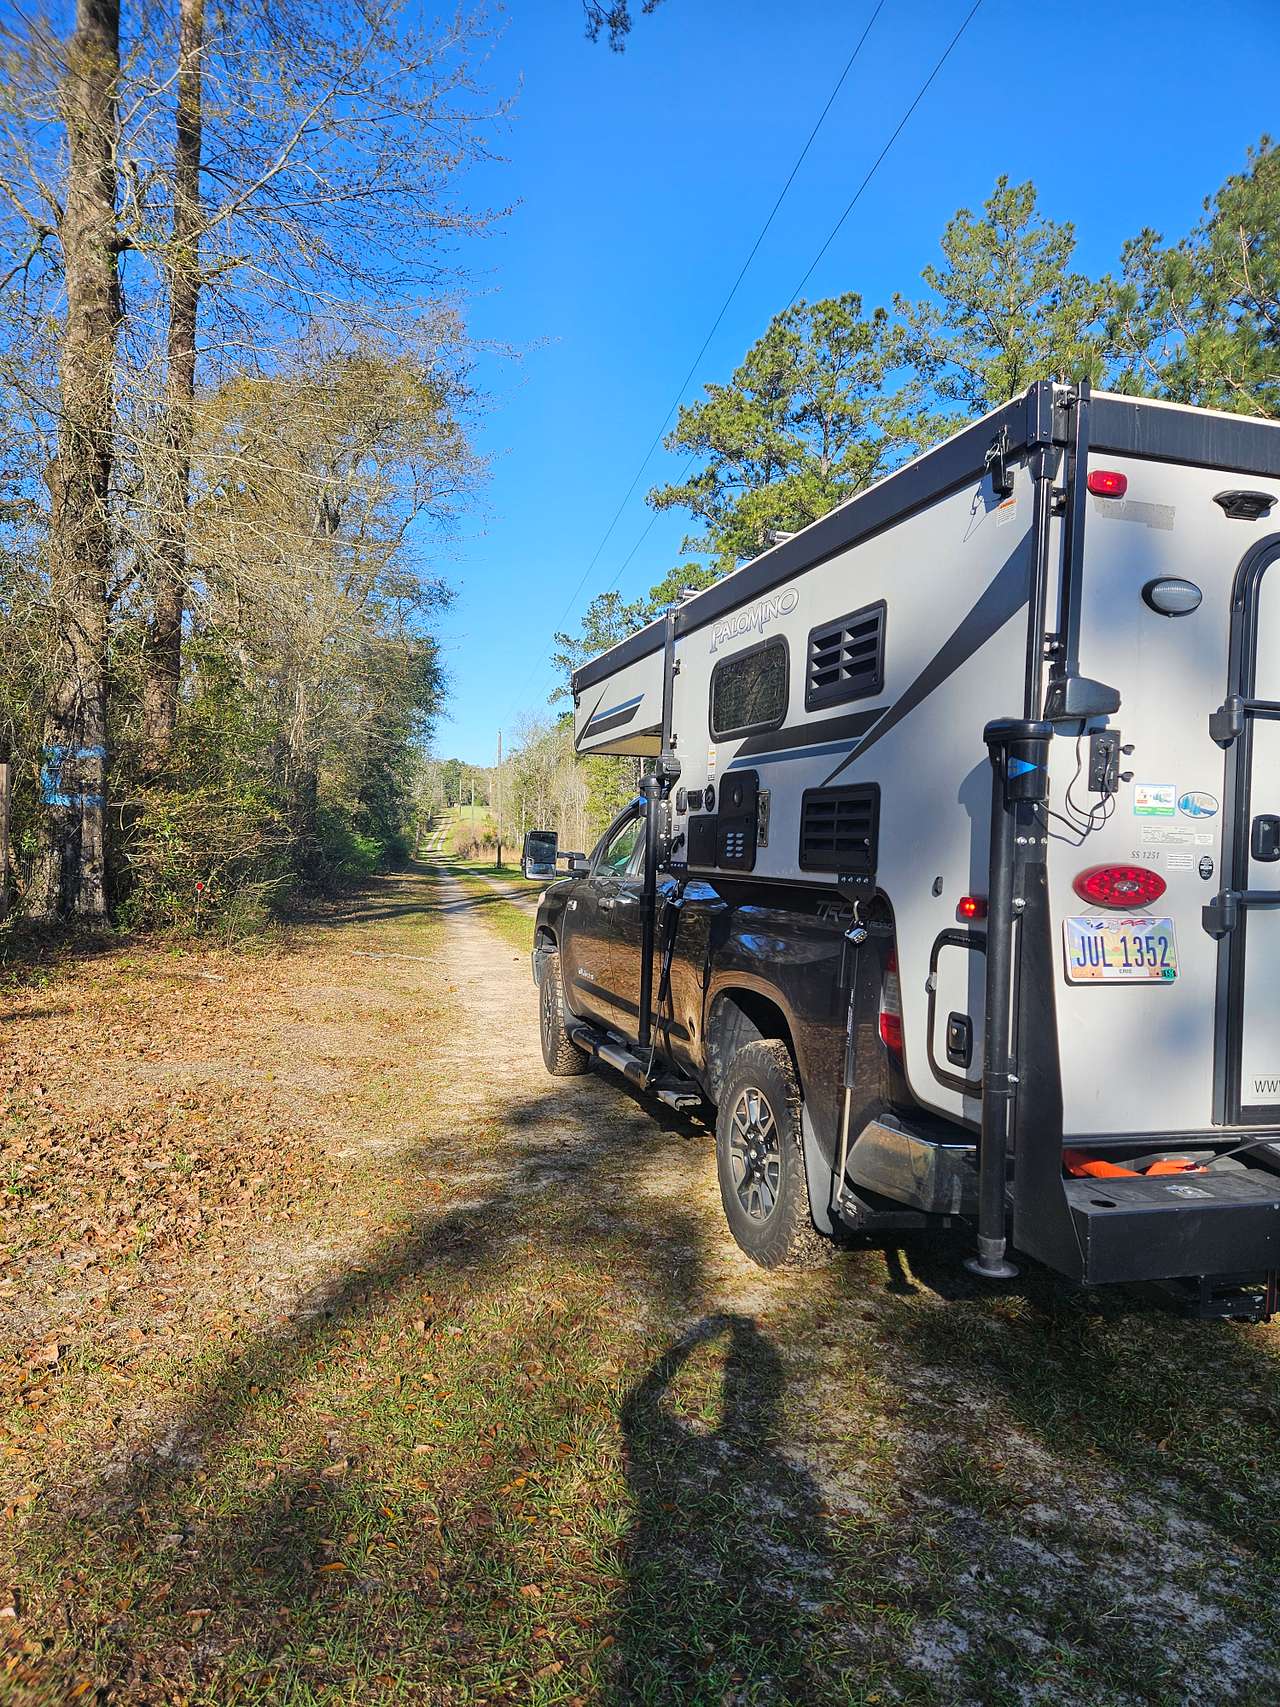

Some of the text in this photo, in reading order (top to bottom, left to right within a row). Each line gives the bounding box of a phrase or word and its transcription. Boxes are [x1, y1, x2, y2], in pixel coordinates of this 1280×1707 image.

[710, 588, 799, 653] PALOMINO
[1131, 850, 1160, 859] SS 1251
[1077, 936, 1170, 967] JUL 1352
